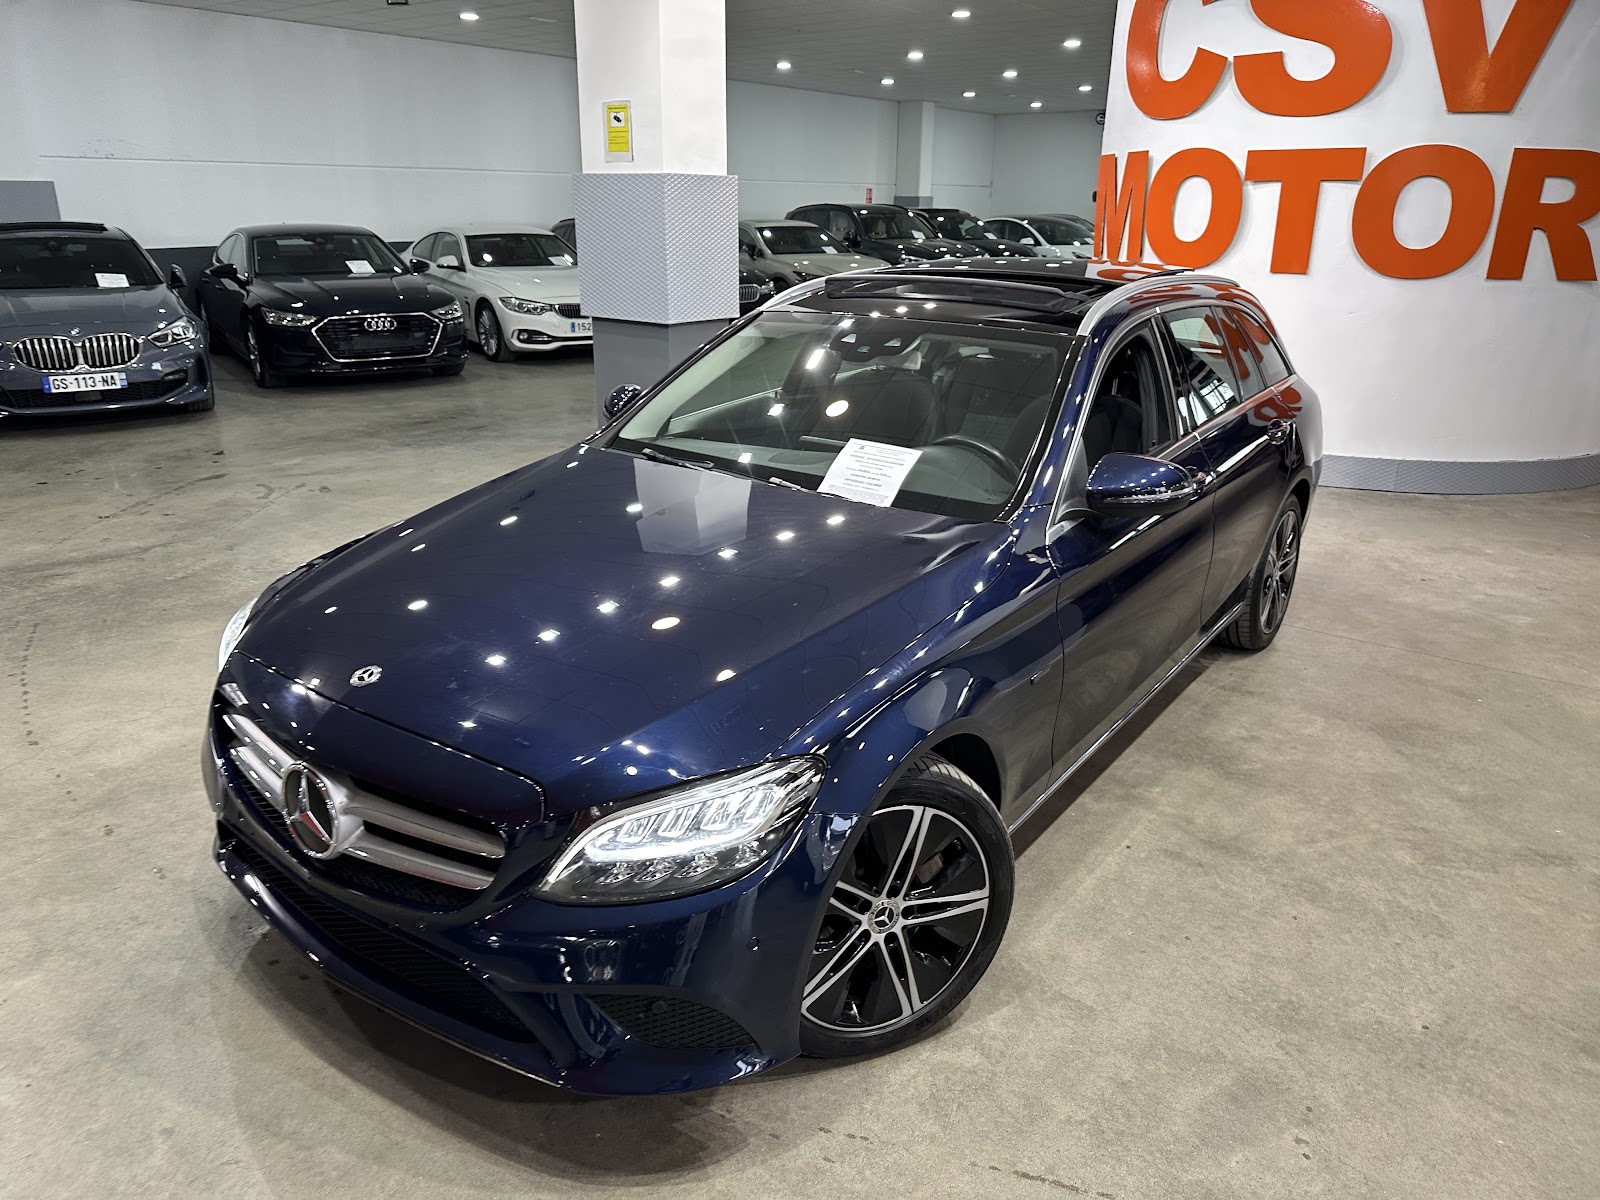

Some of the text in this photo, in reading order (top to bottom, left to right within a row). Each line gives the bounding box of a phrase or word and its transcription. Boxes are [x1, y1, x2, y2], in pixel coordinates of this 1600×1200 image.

[1126, 0, 1571, 120] CSV
[1093, 144, 1600, 281] MOTOR
[577, 322, 592, 331] 152
[52, 375, 117, 390] GS-113-NA
